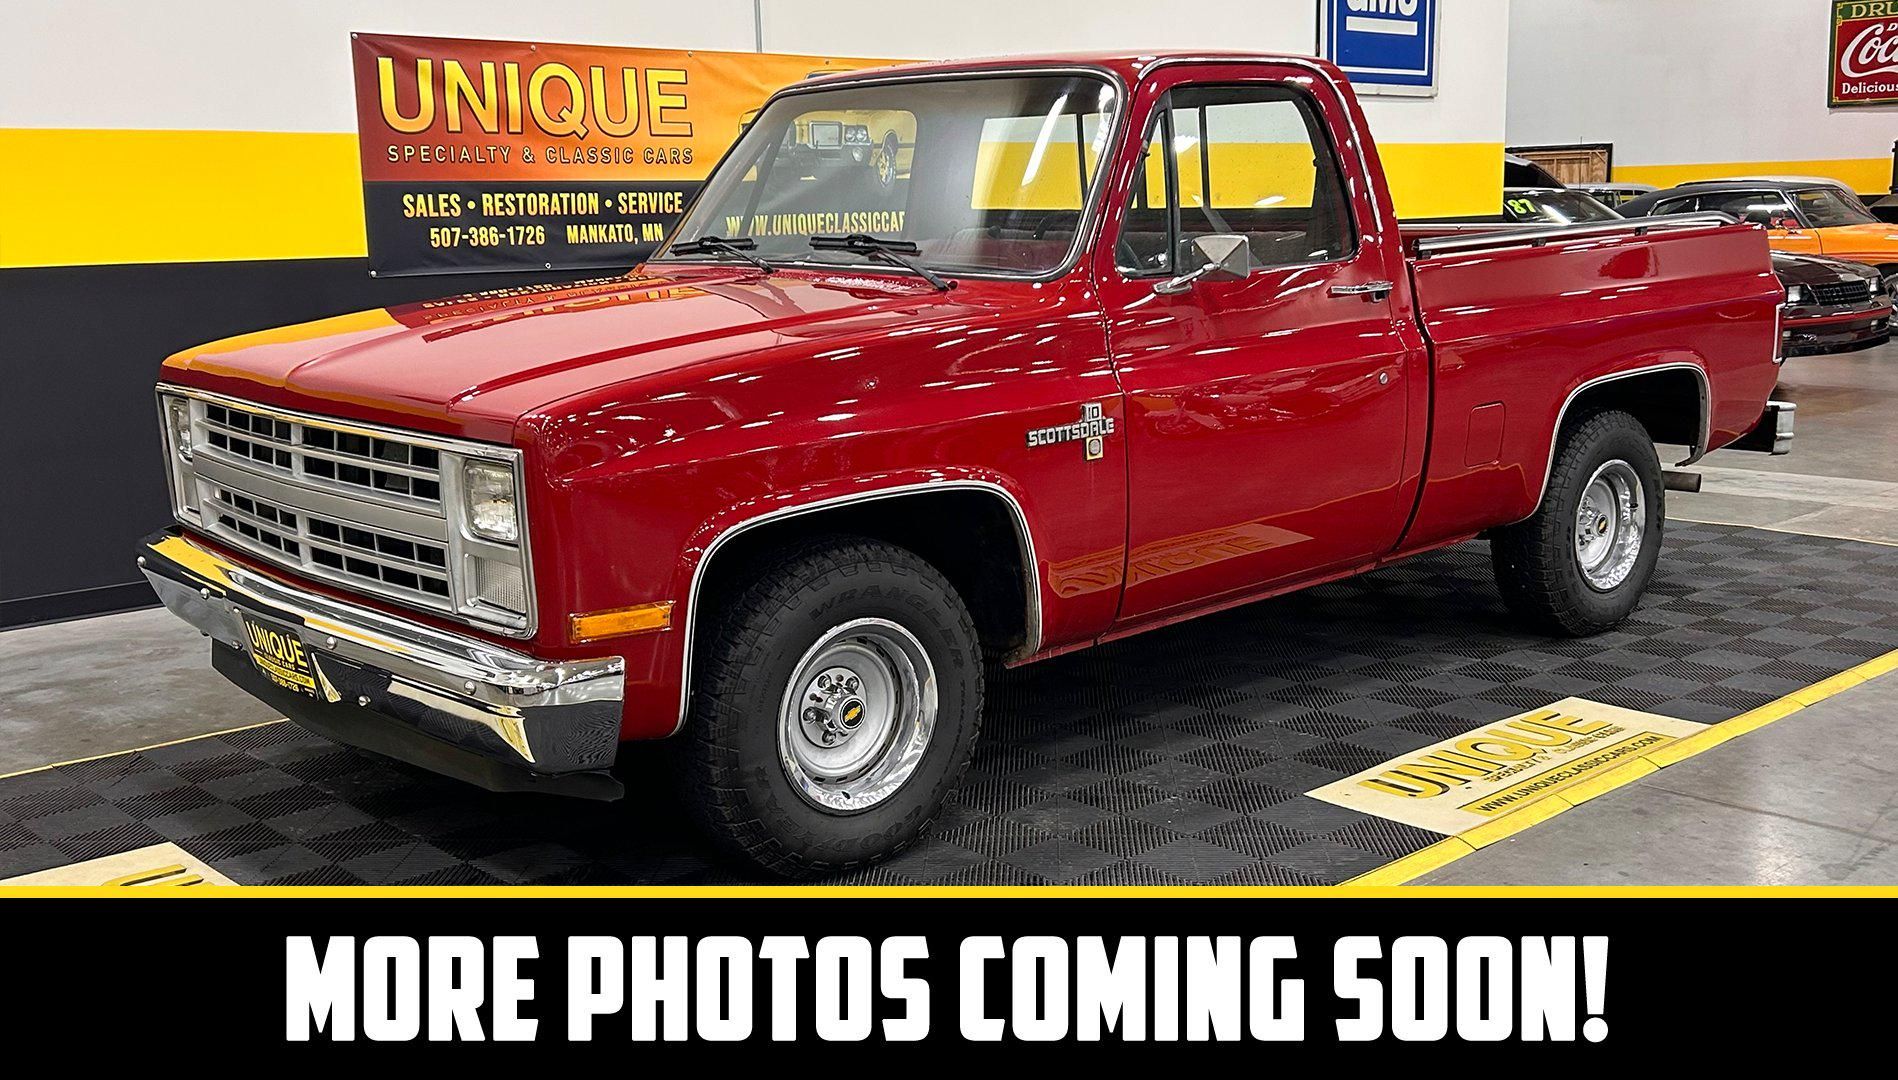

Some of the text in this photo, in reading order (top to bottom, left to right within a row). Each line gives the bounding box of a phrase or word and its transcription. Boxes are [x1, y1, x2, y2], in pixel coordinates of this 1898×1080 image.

[376, 56, 694, 140] UNIQUE
[387, 144, 693, 165] SPECIALTY & CLASSIC CARS
[402, 191, 683, 218] SALES RESTORATION SERVICE
[1507, 198, 1537, 214] 87
[429, 222, 664, 247] 507-386-1726 MANKATO, MN
[1027, 417, 1115, 447] SCOTTSDALE
[245, 620, 308, 668] UNIQUE
[1357, 709, 1614, 799] UNIQUE
[1476, 735, 1662, 812] WWW.UNIQUECLASSICCARS.COM
